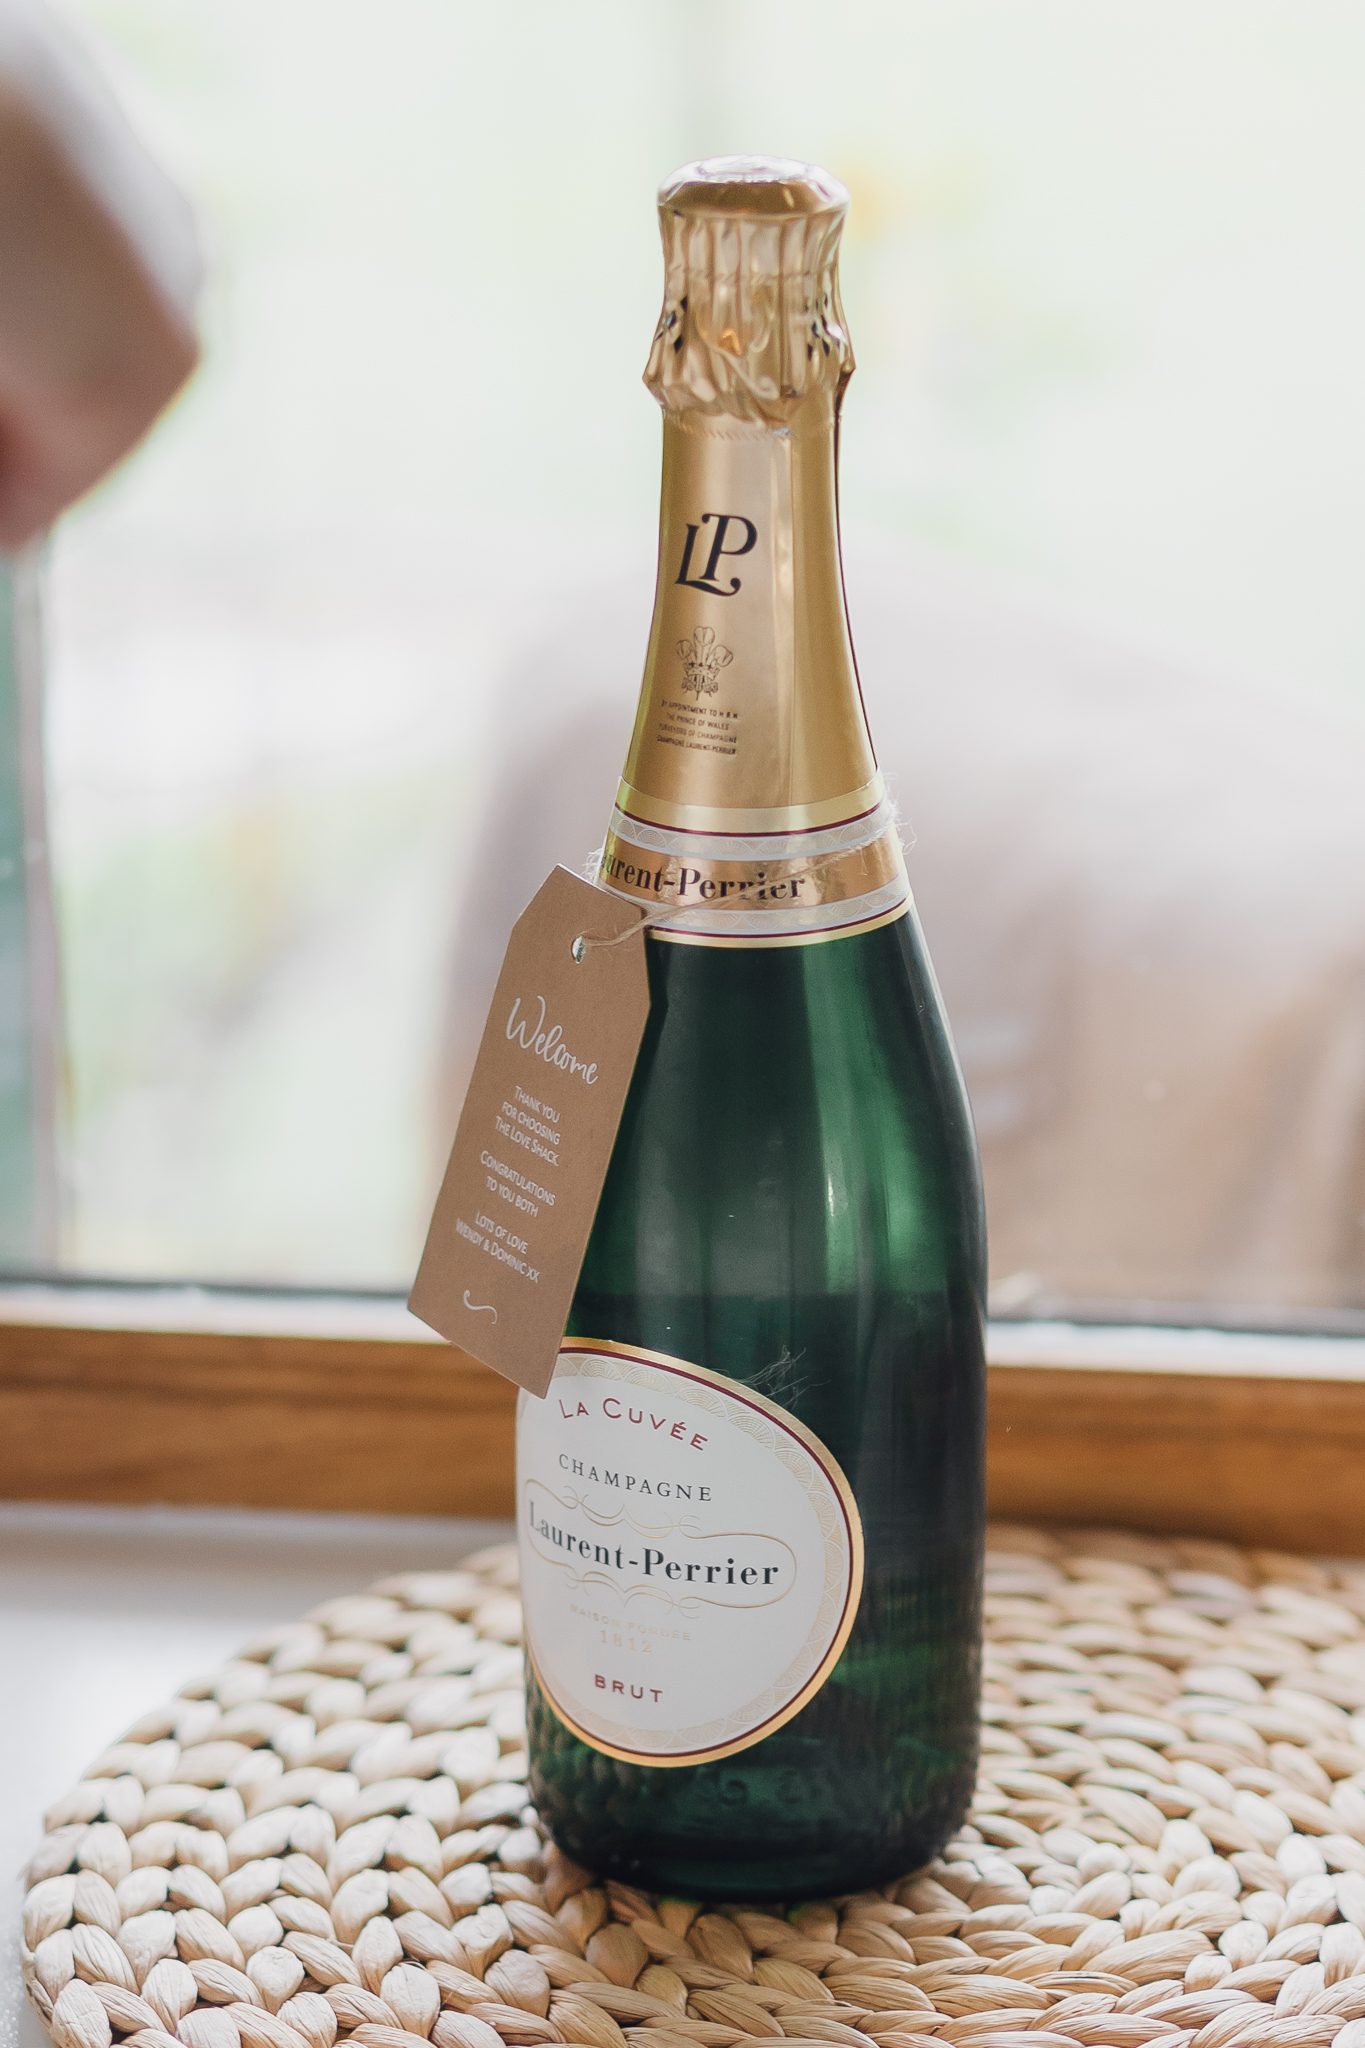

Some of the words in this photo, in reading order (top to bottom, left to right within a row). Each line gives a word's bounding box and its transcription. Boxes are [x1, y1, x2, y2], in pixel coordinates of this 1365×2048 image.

[676, 715, 696, 726] PRINCE
[698, 719, 705, 727] OF
[707, 721, 729, 731] WALES
[709, 708, 718, 717] TO
[688, 729, 696, 737] OF
[697, 731, 737, 744] CHAMPAGNE
[506, 995, 599, 1084] Welcome
[501, 1101, 518, 1120] FOR
[517, 1111, 561, 1146] CHOOSING
[514, 1085, 542, 1113] THANK
[541, 1103, 561, 1124] YOU
[495, 1115, 511, 1137] THE
[509, 1125, 532, 1150] LOVE
[531, 1138, 560, 1167] SHACK
[480, 1149, 556, 1207] CONGRATULATIONS
[486, 1175, 498, 1192] TO
[499, 1183, 516, 1203] YOU
[515, 1194, 539, 1218] BOTH
[455, 1218, 485, 1246] WENDY
[483, 1239, 491, 1252] &
[490, 1241, 528, 1275] DOMINIC
[526, 1265, 541, 1284] XX
[475, 1210, 496, 1234] LOTS
[495, 1225, 508, 1240] OF
[506, 1232, 529, 1255] LOVE
[559, 1399, 590, 1419] LA
[602, 1397, 709, 1452] CUVÉE
[558, 1453, 713, 1502] CHAMPAGNE
[528, 1500, 780, 1586] Laurent-Perrier
[570, 1603, 621, 1628] MAISON
[600, 1629, 653, 1655] 1812
[594, 1673, 664, 1704] BRUT
